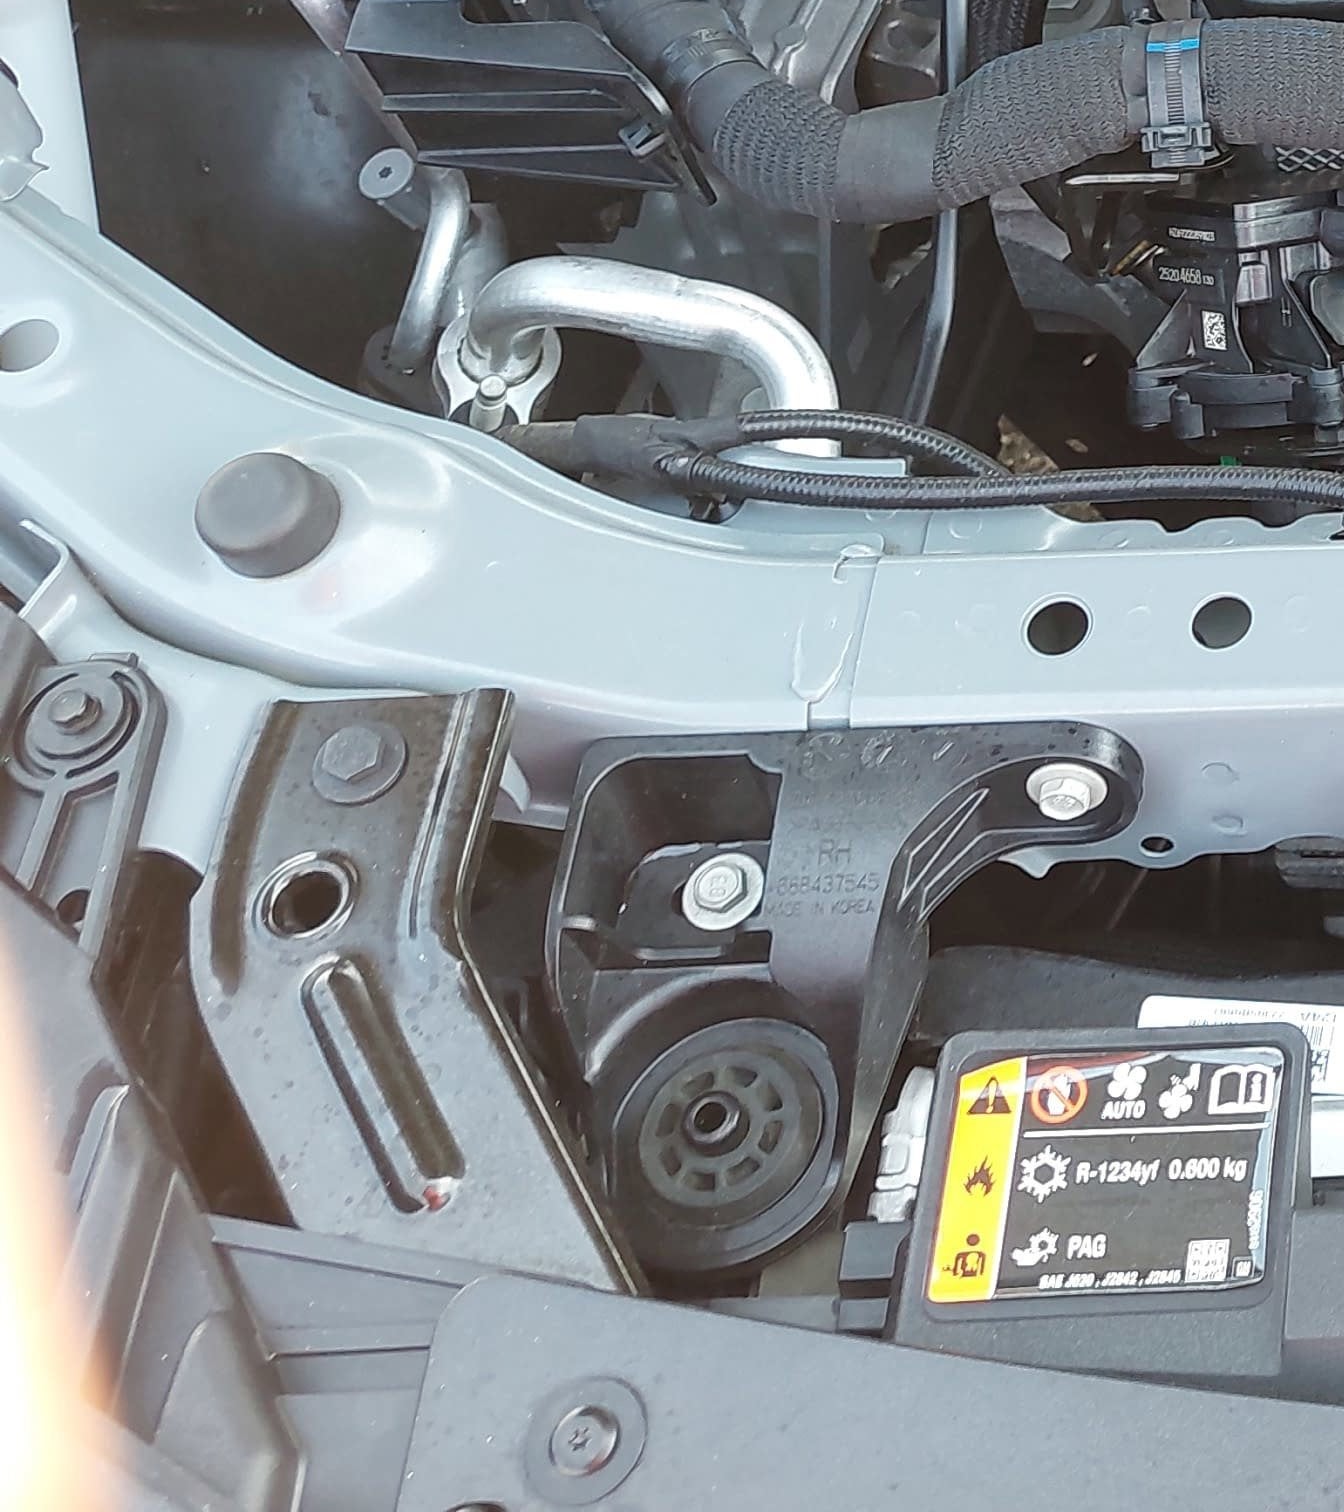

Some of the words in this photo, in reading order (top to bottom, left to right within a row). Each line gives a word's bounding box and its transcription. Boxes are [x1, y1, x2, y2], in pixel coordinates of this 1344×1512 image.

[1101, 1100, 1146, 1120] AUTO
[1075, 1159, 1160, 1186] R-1234yf
[1168, 1157, 1220, 1181] 0.600
[1222, 1156, 1248, 1182] kg
[1067, 1234, 1108, 1260] PAG
